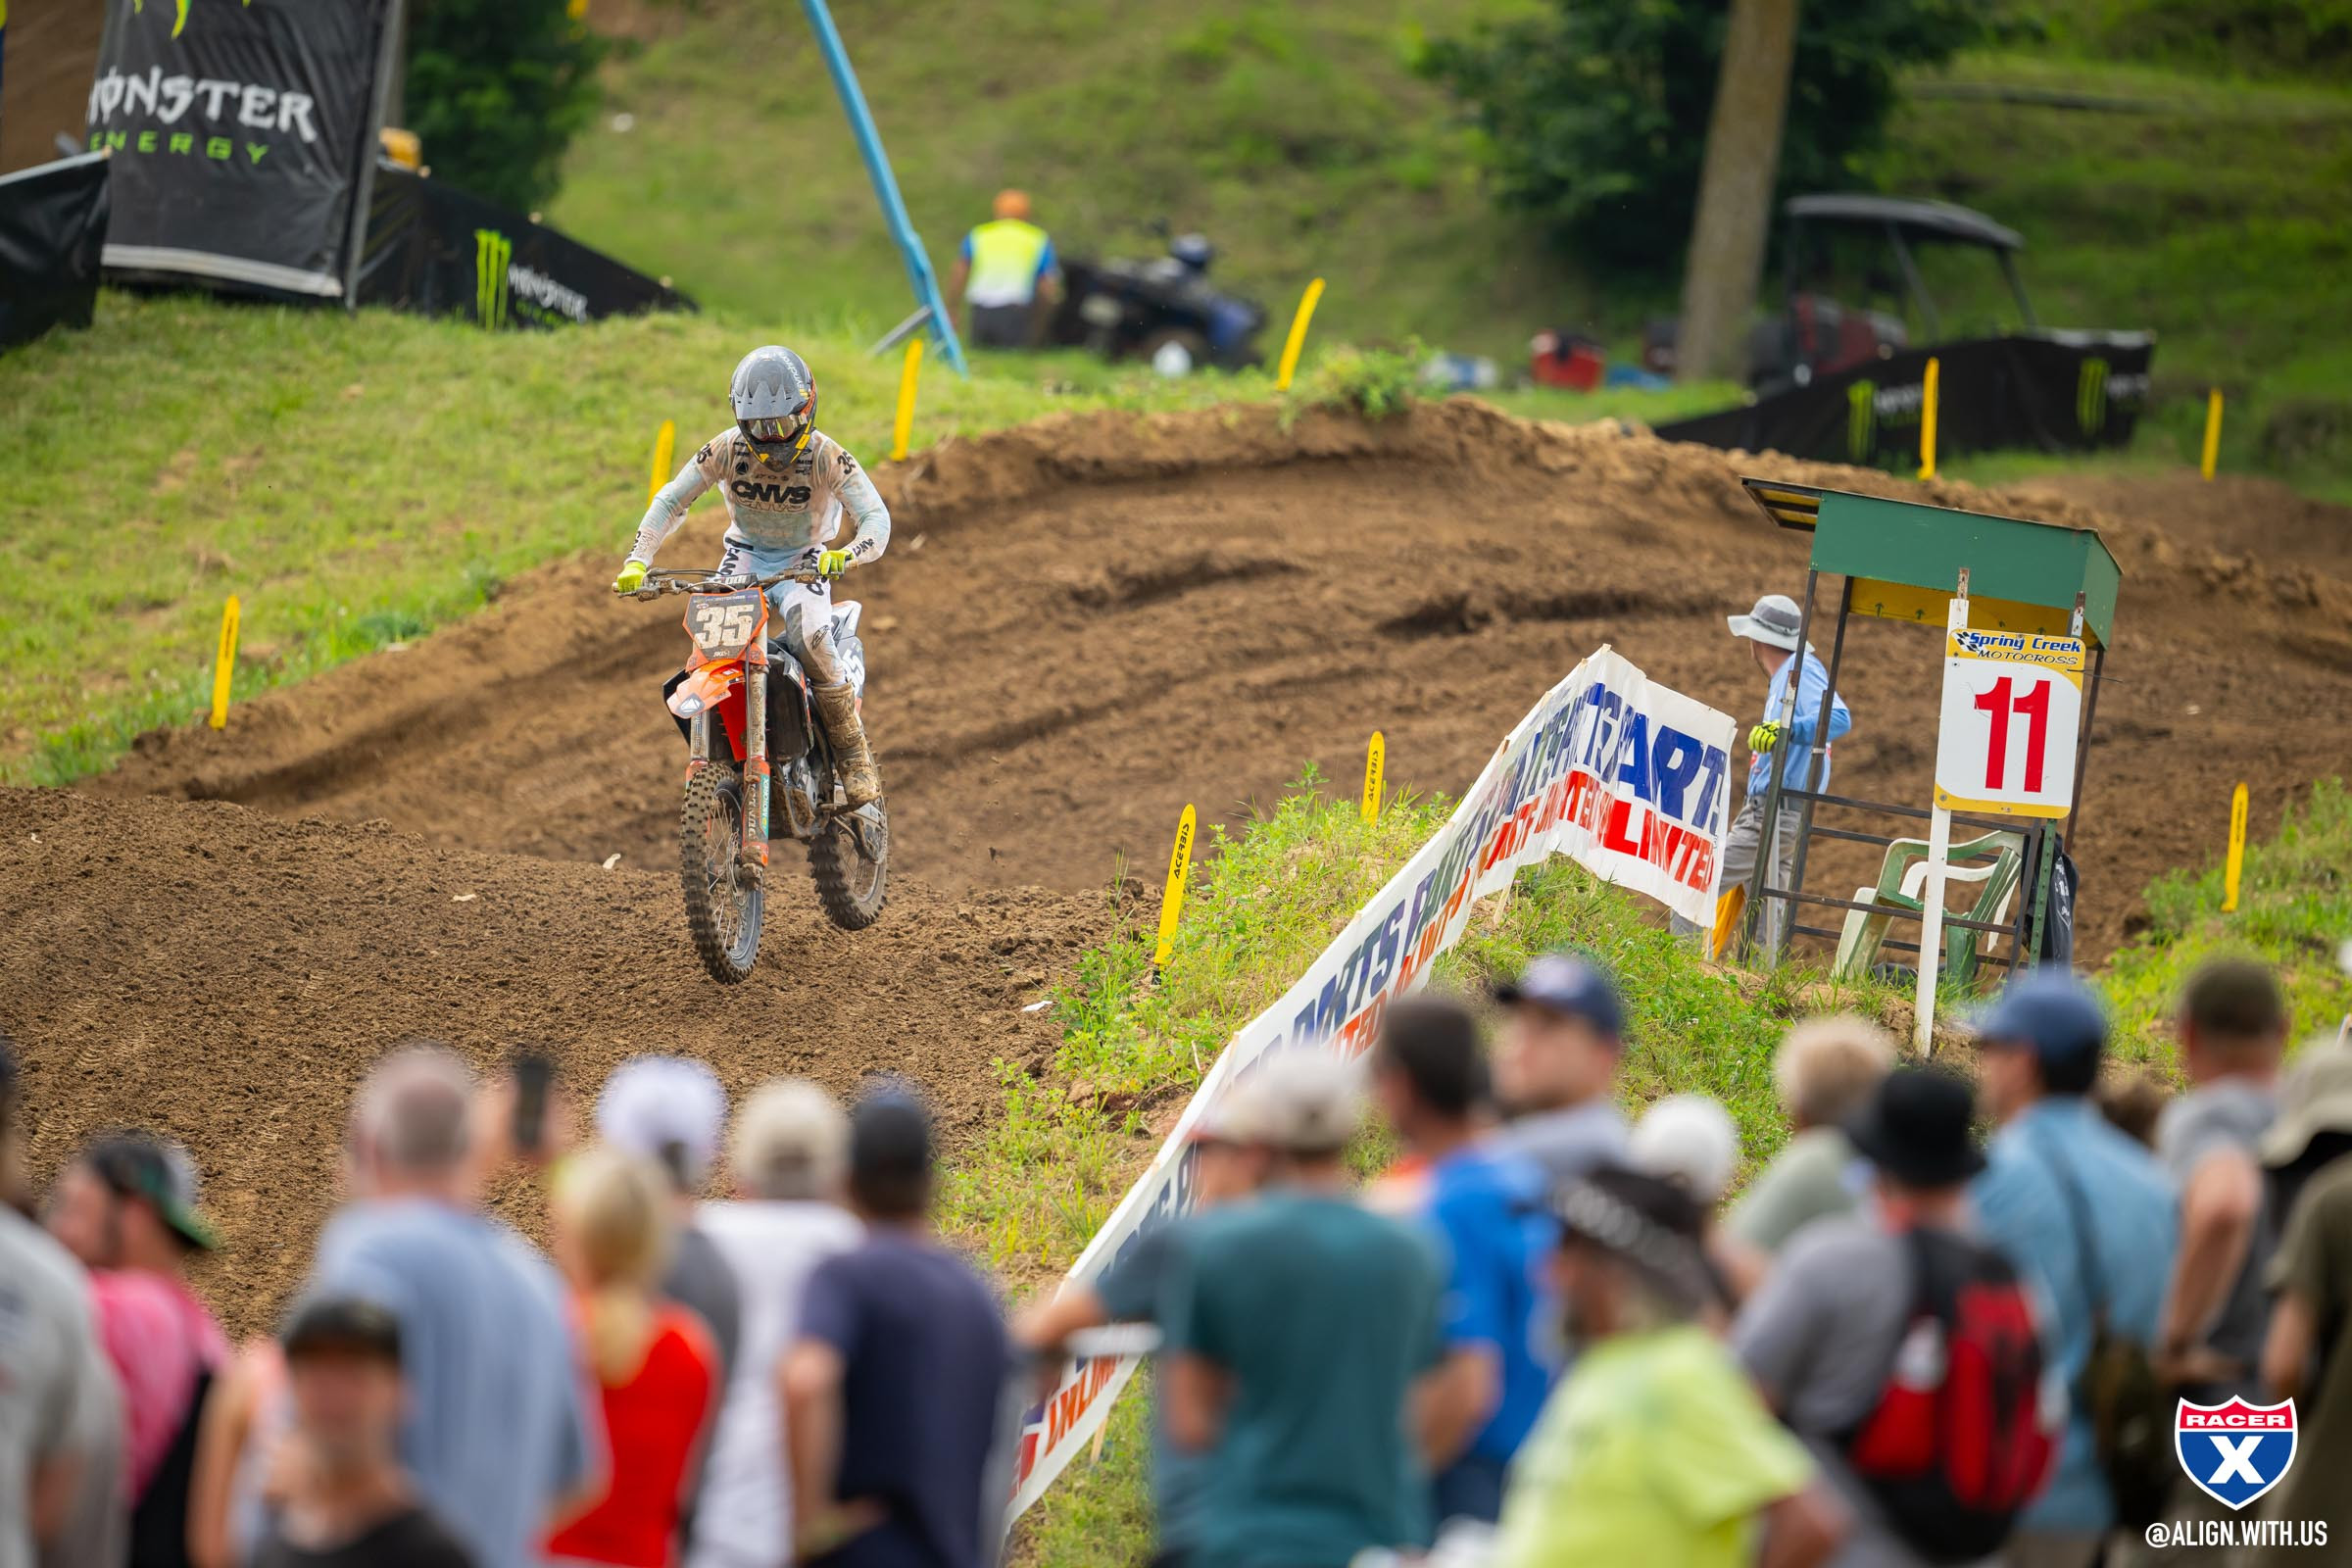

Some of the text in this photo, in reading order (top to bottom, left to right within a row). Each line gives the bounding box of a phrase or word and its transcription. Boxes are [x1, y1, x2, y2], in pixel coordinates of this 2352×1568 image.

[695, 604, 755, 649] 35
[1970, 632, 2081, 653] Spring Creek
[1977, 649, 2079, 665] MOTOCROSS
[1974, 676, 2051, 793] 11
[1173, 822, 1190, 879] ACERBIS
